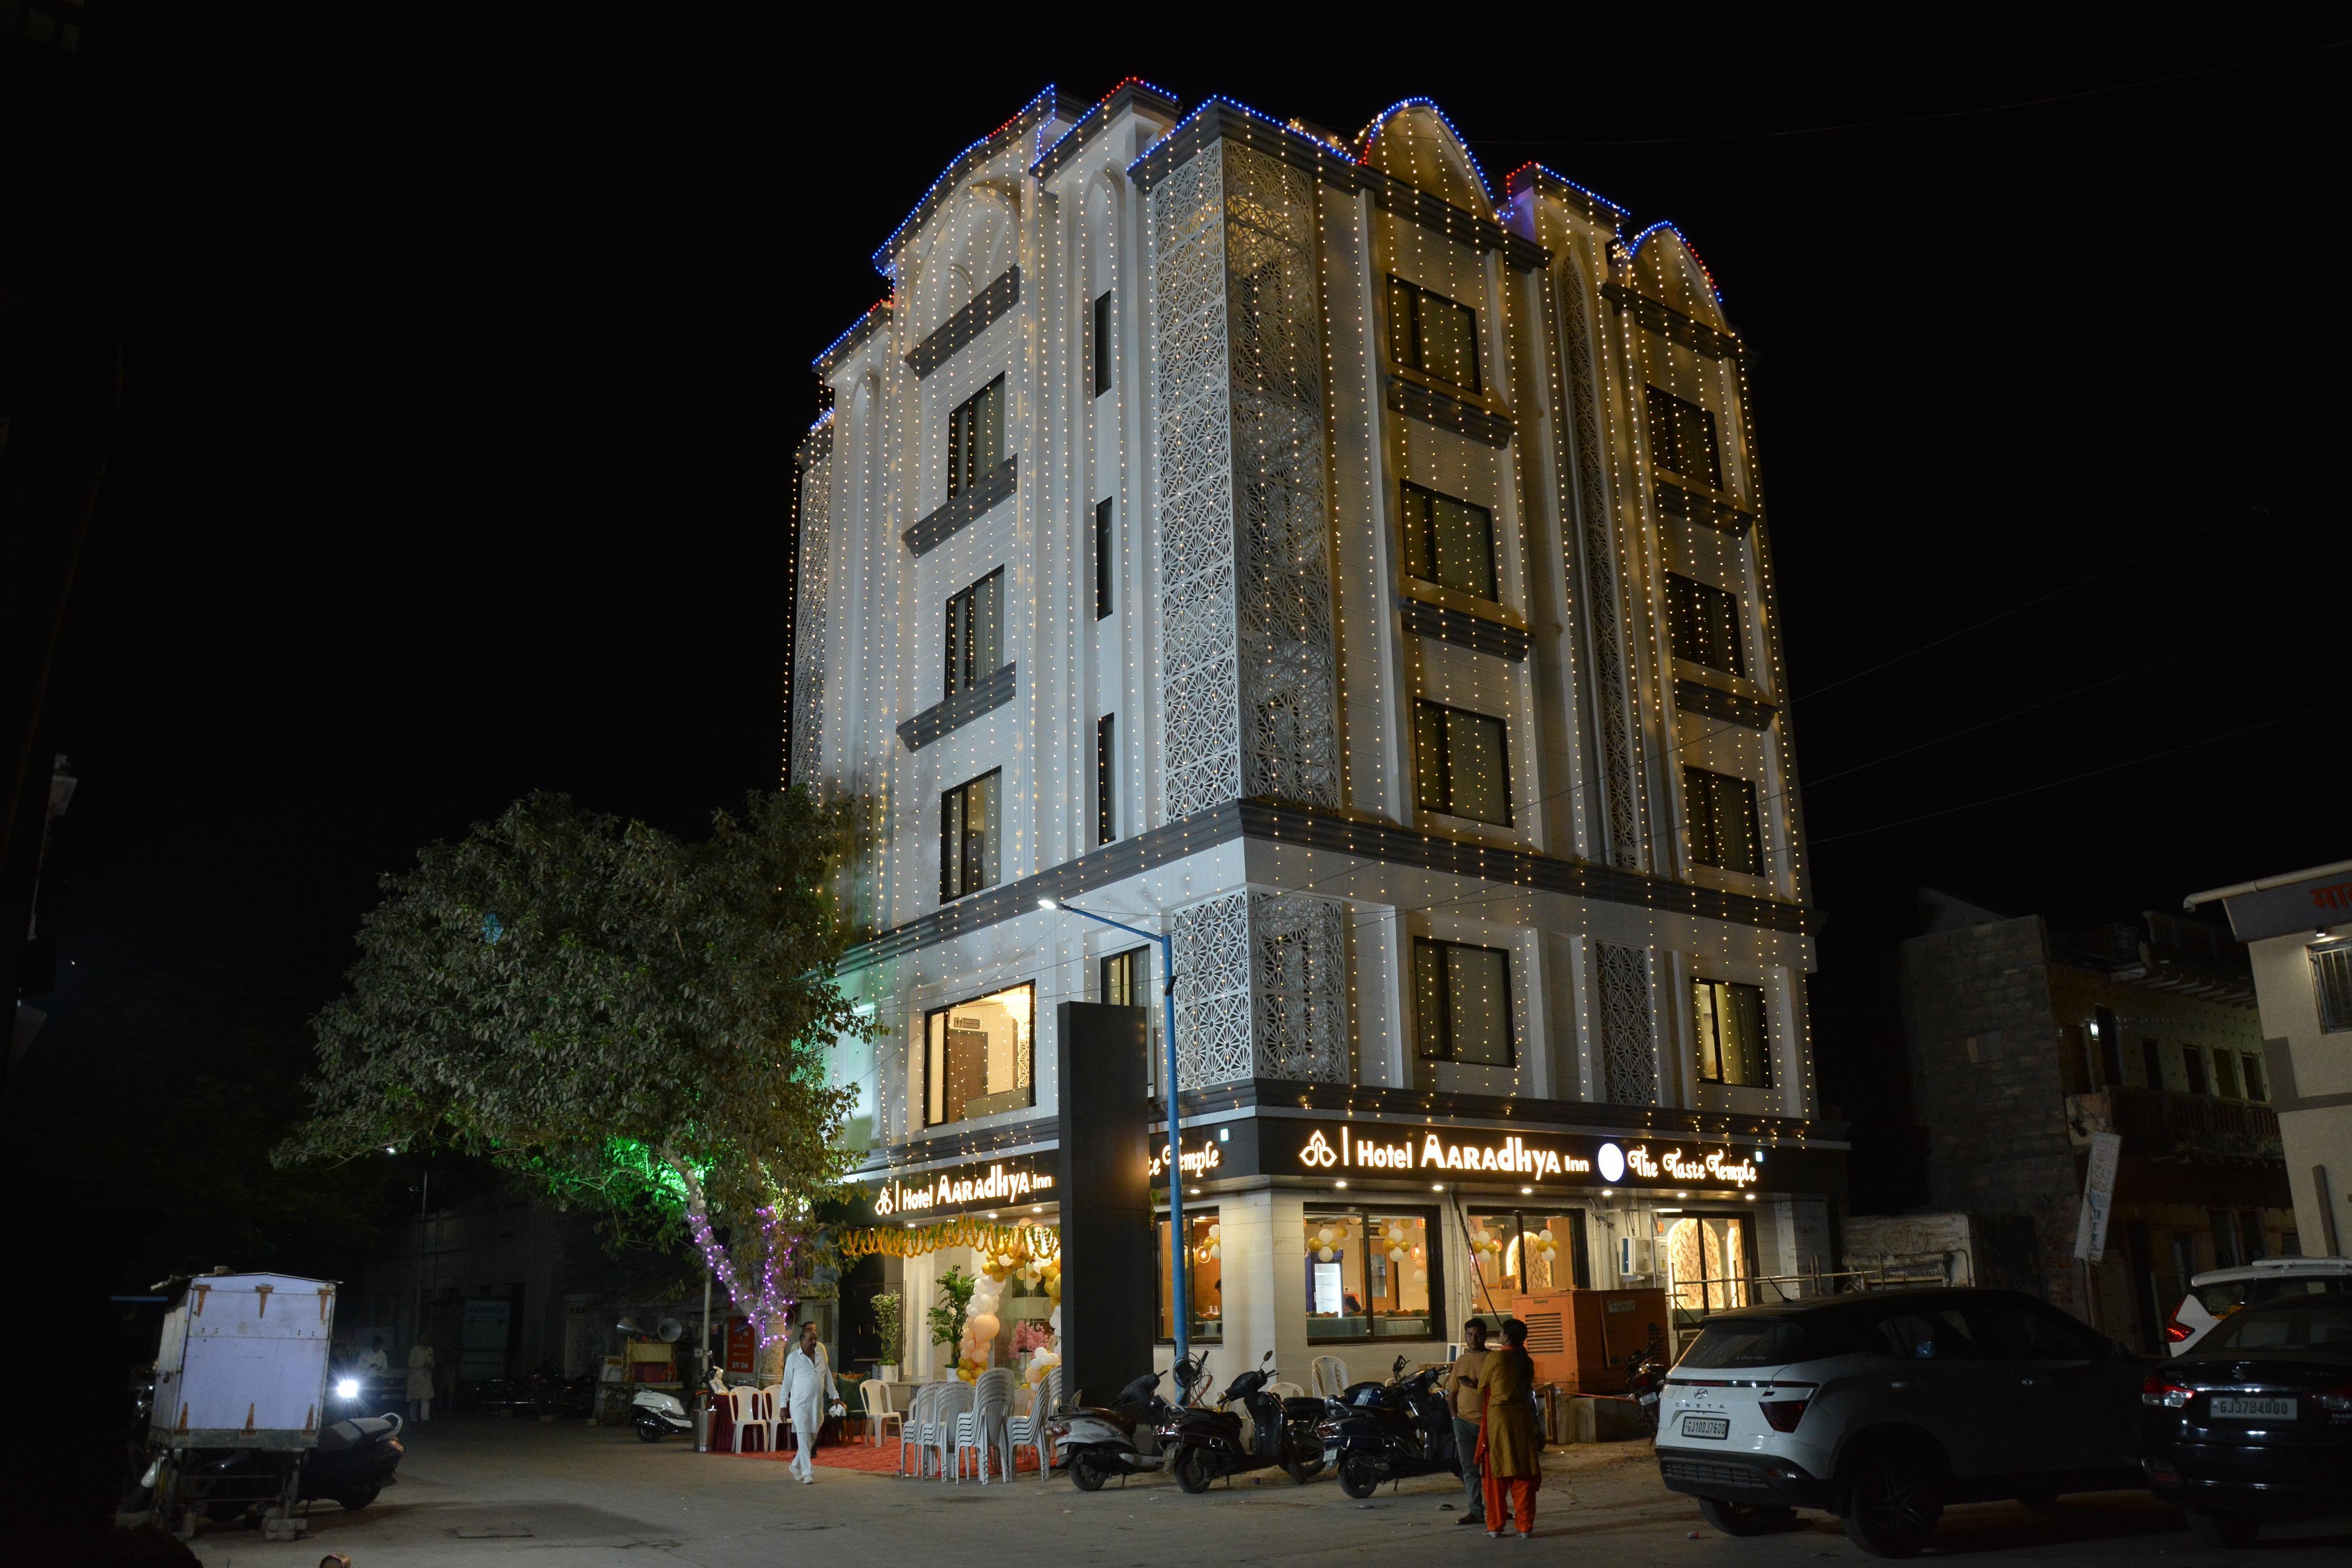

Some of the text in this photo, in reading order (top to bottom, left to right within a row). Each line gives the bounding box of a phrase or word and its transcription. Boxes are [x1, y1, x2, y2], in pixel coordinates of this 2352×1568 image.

[1357, 1140, 1412, 1168] Hotel
[1564, 1155, 1589, 1172] Inn
[1628, 1144, 1757, 1187] The Taste Temple
[902, 1183, 933, 1210] Hotel
[1033, 1174, 1052, 1190] Inn
